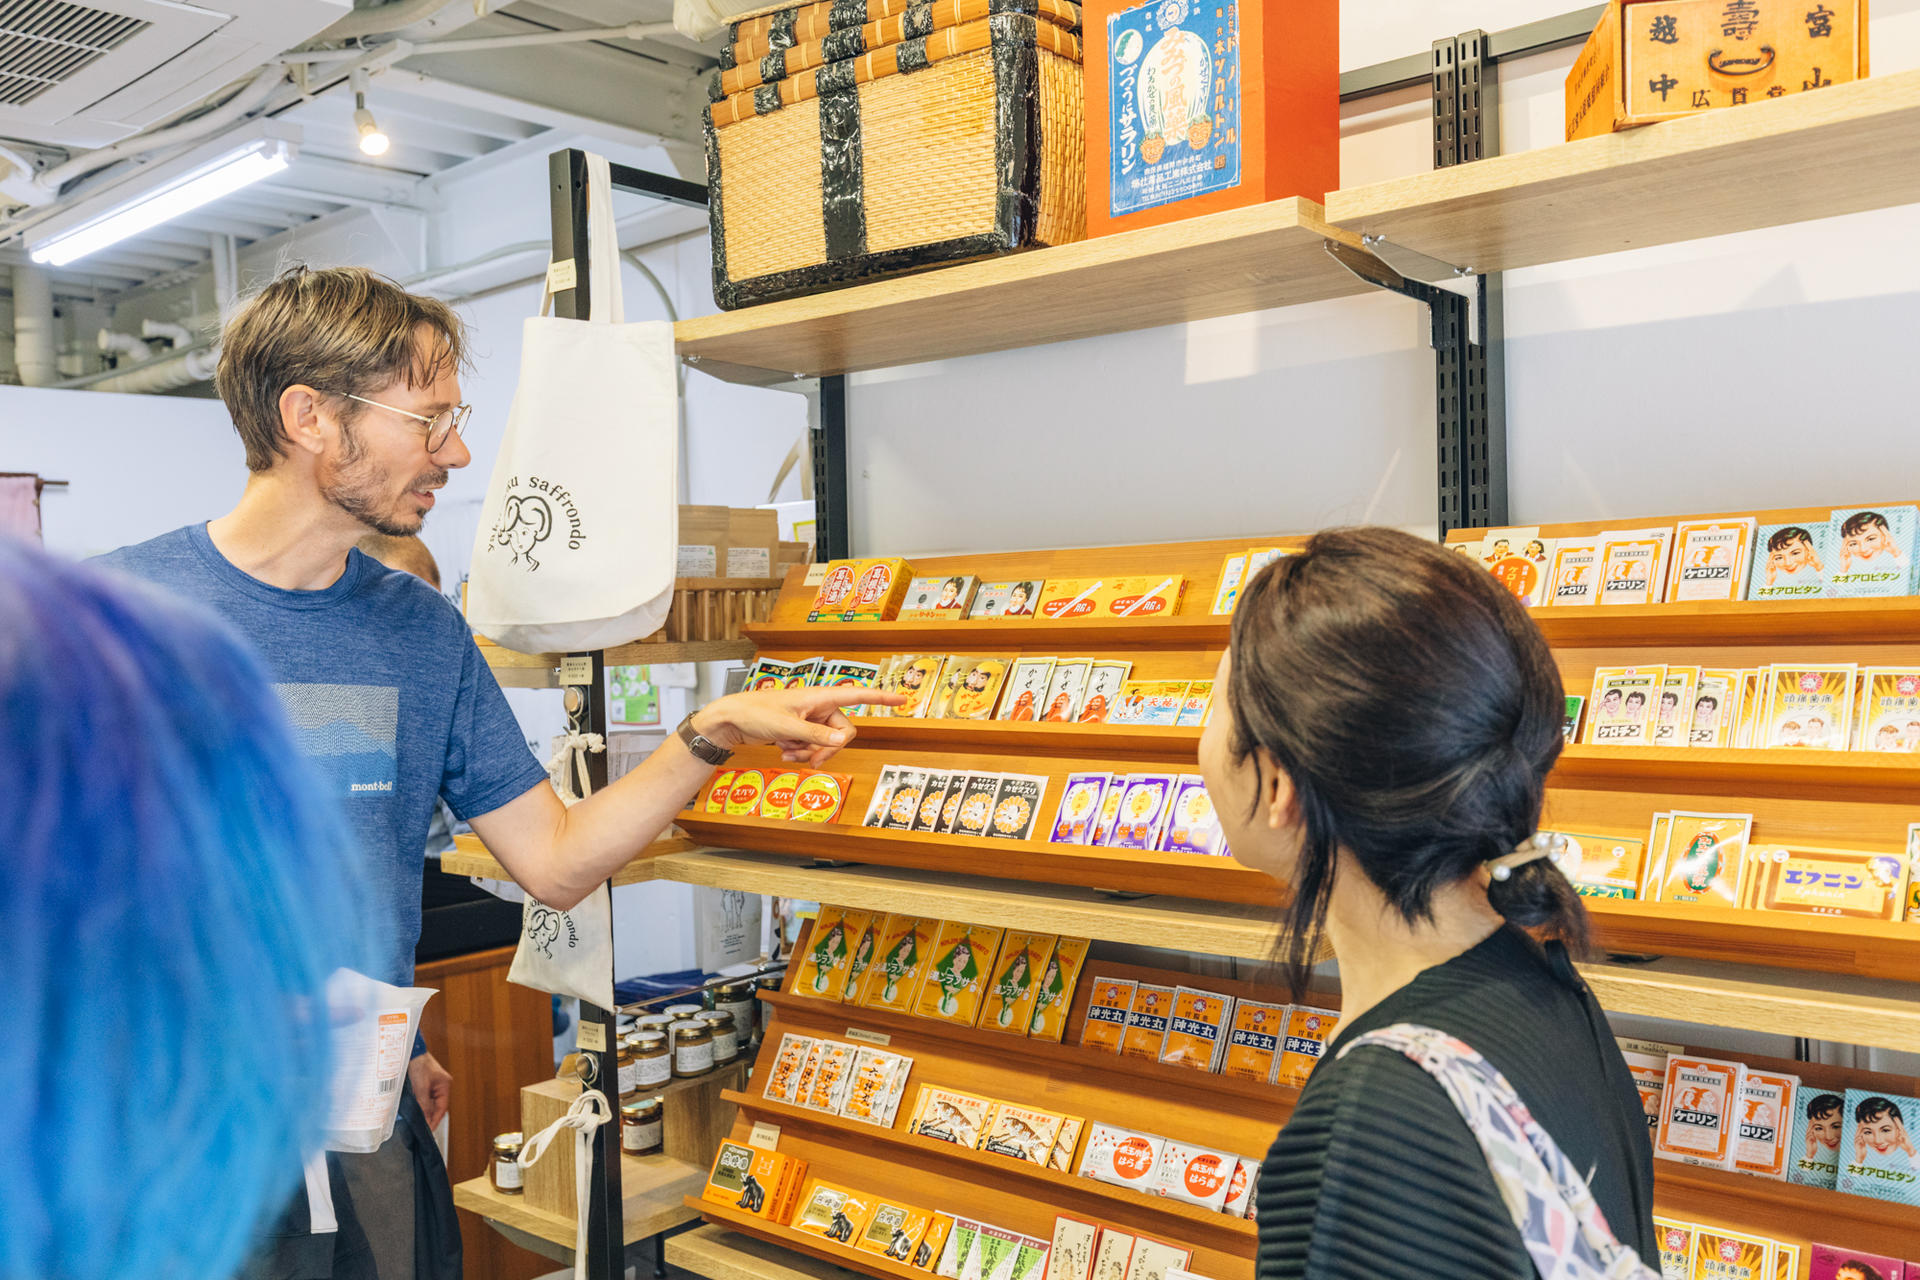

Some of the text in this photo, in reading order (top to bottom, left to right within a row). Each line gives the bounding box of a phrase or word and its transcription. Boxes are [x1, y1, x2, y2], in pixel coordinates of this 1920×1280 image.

[529, 476, 586, 550] saffrondo
[1685, 567, 1730, 579] ケロリン
[1607, 580, 1645, 590] ケロリン
[1785, 870, 1863, 889] エフニン
[1090, 1007, 1124, 1022] 神光丸
[1128, 1013, 1164, 1030] 神光丸
[1172, 1018, 1215, 1038] 神光丸
[1233, 1031, 1273, 1049] 神光丸
[1674, 1109, 1718, 1127] ケロリン
[1741, 1124, 1773, 1141] ロリン
[1798, 1159, 1838, 1174] ネオアロ
